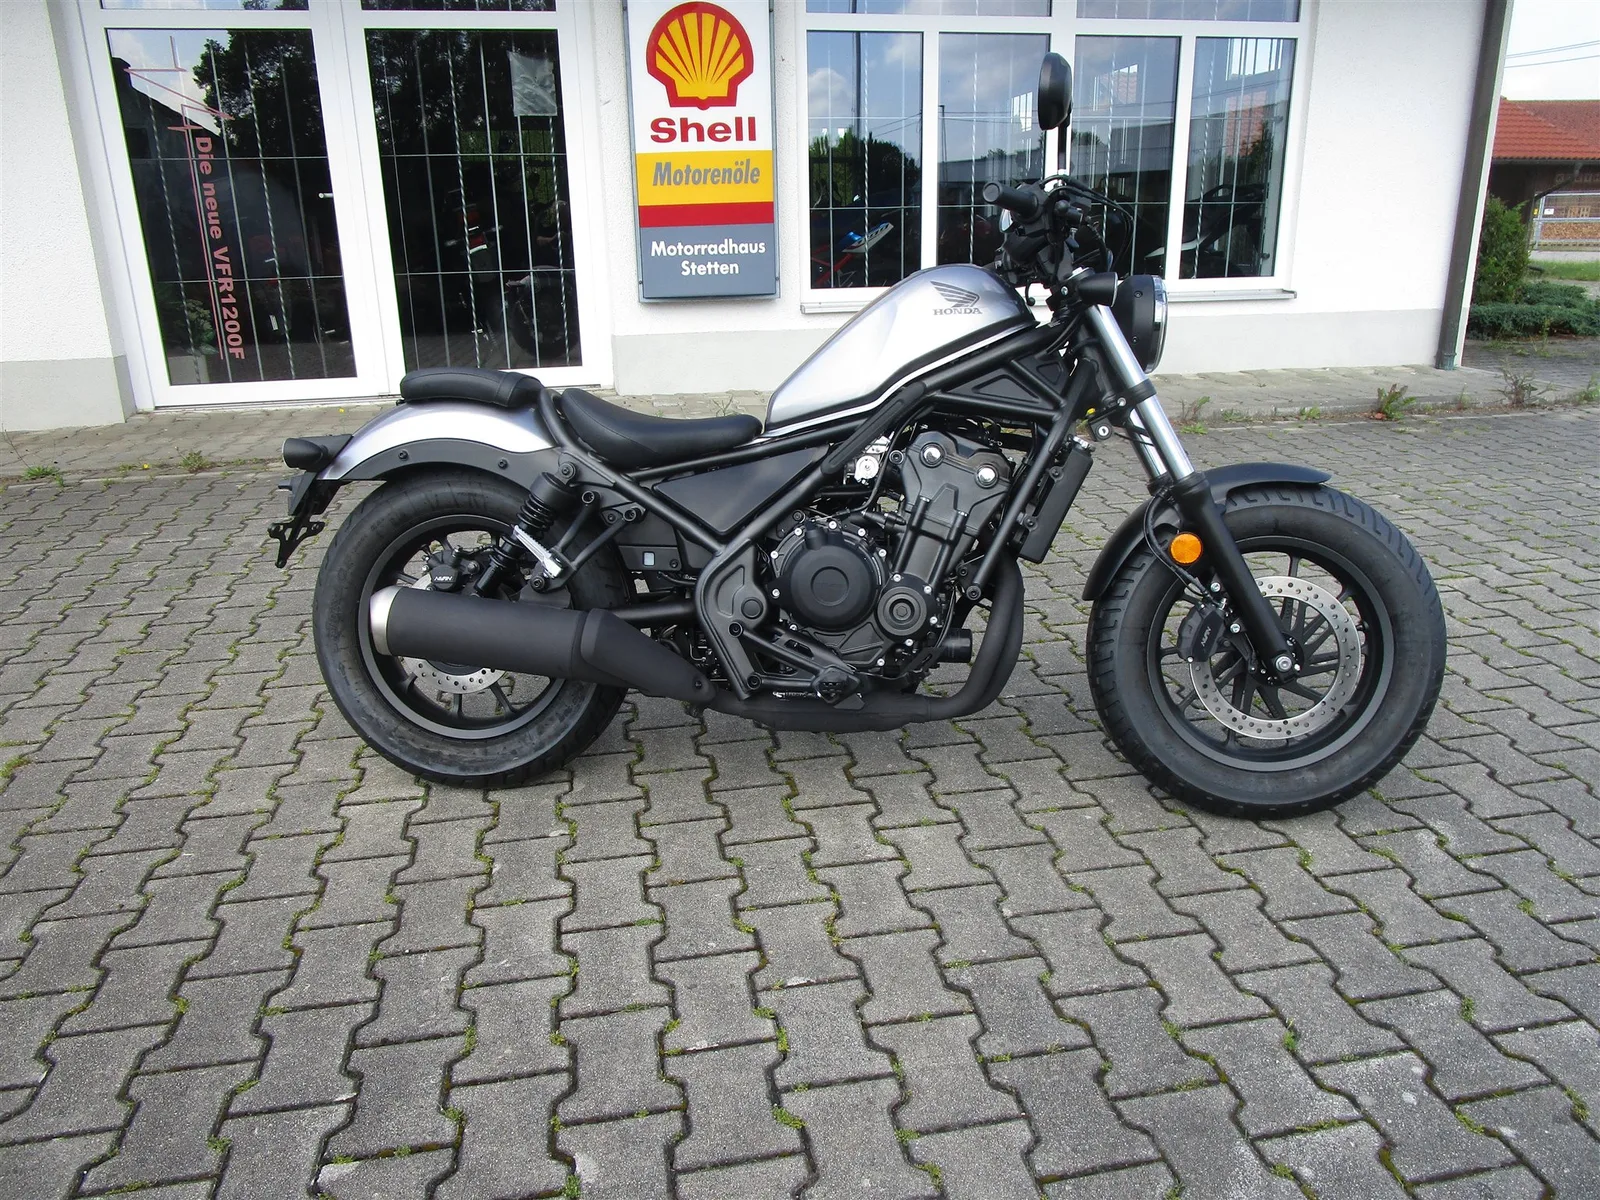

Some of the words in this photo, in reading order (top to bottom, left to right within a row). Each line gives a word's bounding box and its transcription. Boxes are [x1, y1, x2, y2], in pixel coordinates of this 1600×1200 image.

[650, 116, 756, 143] Shell
[195, 137, 213, 175] Die
[653, 159, 760, 187] Motorenöle
[202, 182, 221, 240] neue
[651, 238, 766, 257] Motorradhaus
[681, 261, 739, 276] Stetten
[213, 246, 245, 360] VFR1200F
[933, 308, 982, 316] HONDA
